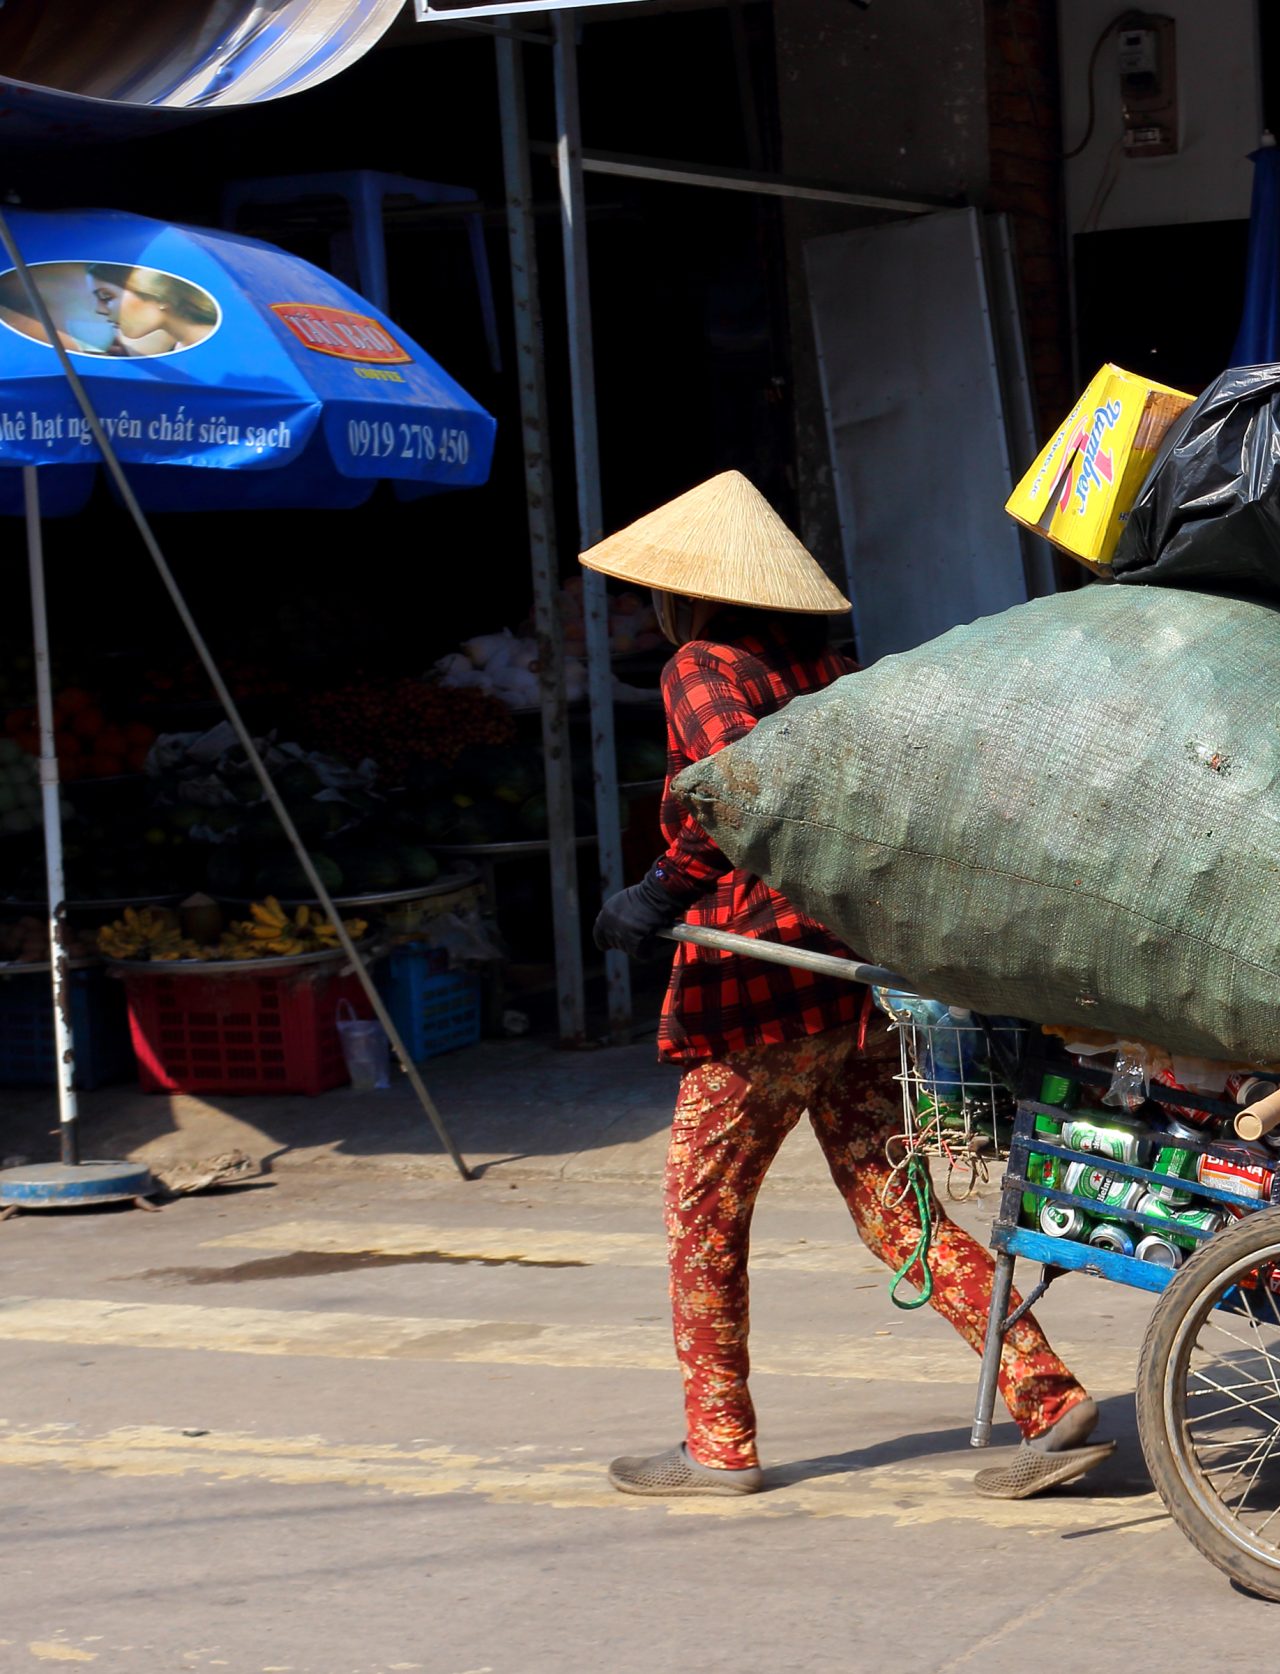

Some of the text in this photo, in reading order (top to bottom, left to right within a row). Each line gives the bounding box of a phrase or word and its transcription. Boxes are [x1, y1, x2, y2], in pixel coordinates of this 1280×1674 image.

[0, 405, 291, 454] hê hạt ngyên chất siêu sạch
[348, 419, 469, 465] 0919 278 450
[1075, 399, 1121, 515] Number
